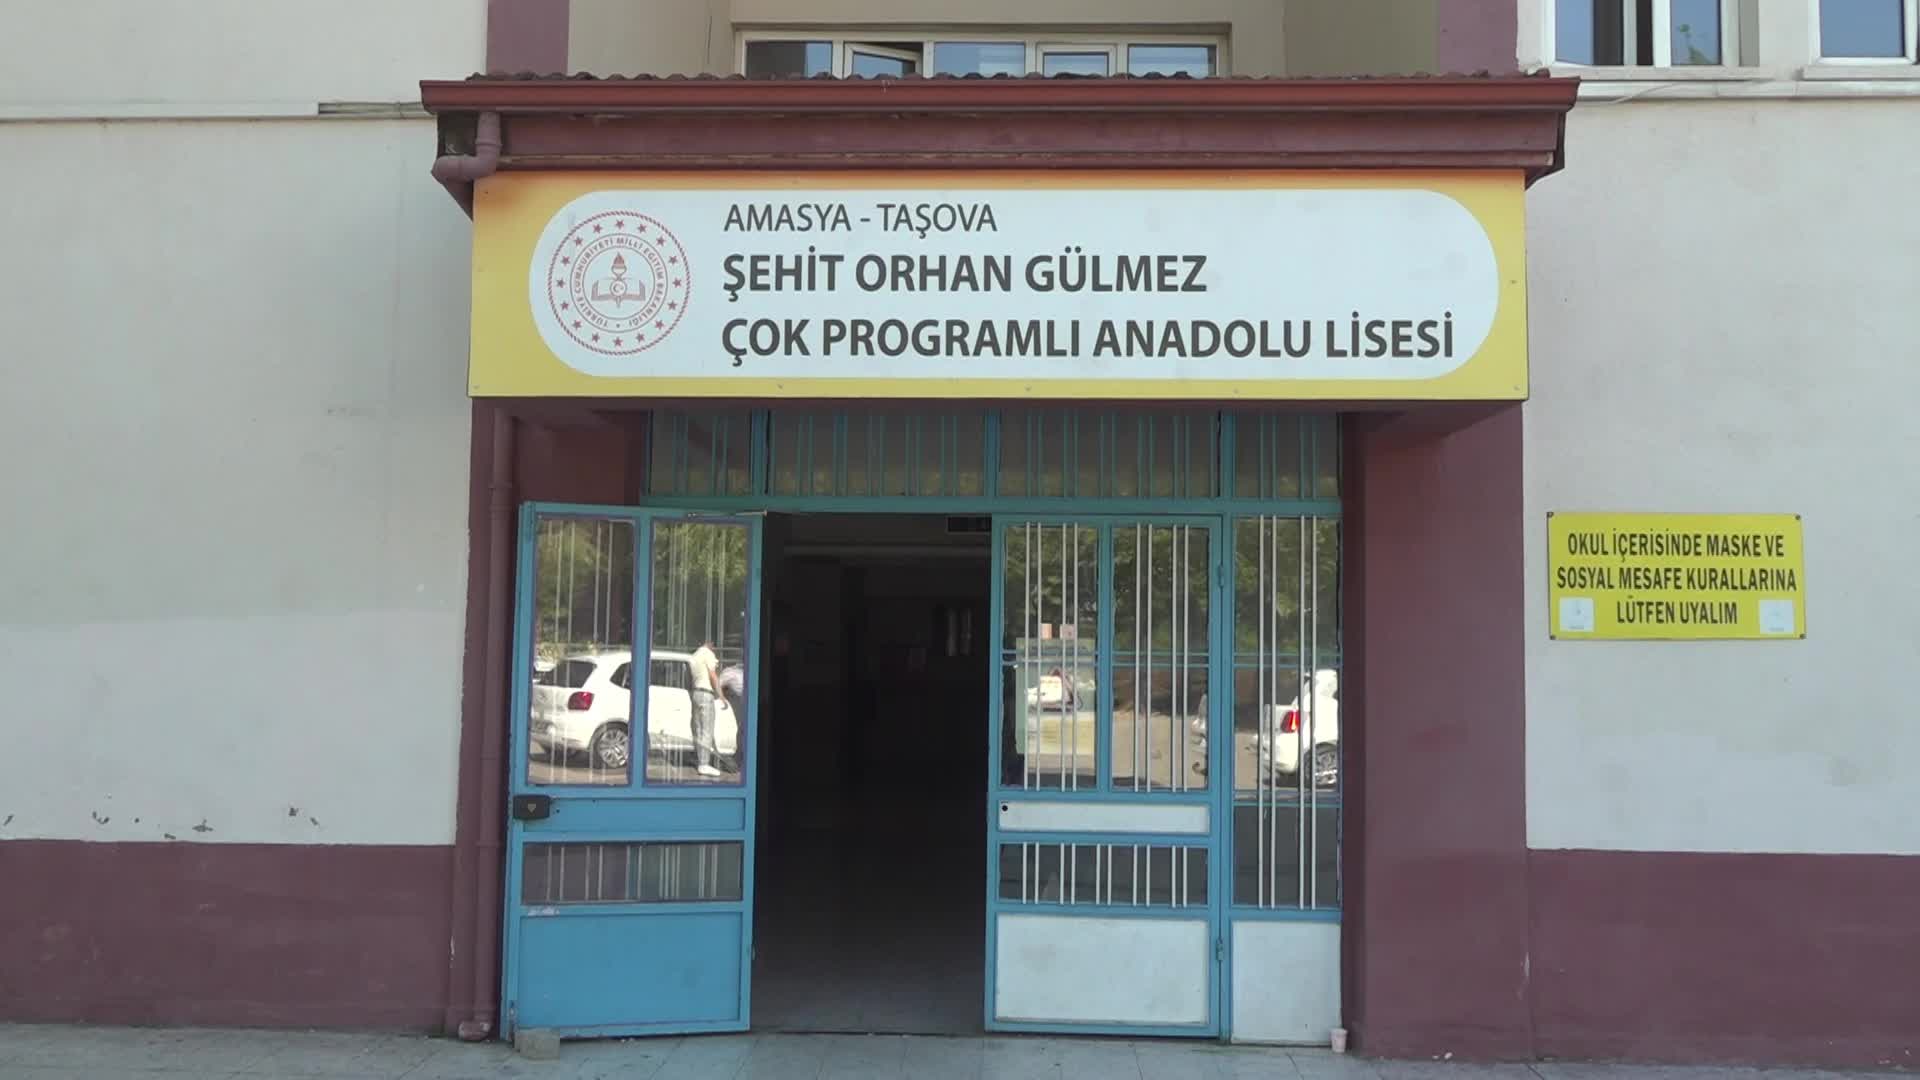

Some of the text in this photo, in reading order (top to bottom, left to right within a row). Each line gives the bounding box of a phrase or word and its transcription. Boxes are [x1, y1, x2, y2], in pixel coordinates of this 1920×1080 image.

[723, 203, 852, 232] AMASYA
[876, 203, 998, 240] TAŞOVA
[722, 246, 1208, 303] ŞEHİT ORHAN GÜLMEZ
[721, 311, 1453, 368] ÇOK PROGRAMLI ANADOLU LİSESİ
[1567, 528, 1785, 563] OKUL İÇERİSİNDE MASKE VE
[1556, 566, 1797, 592] SOSYAL MESAFE KURALLARINA
[1616, 595, 1738, 625] LÜTFEN UYALIM
